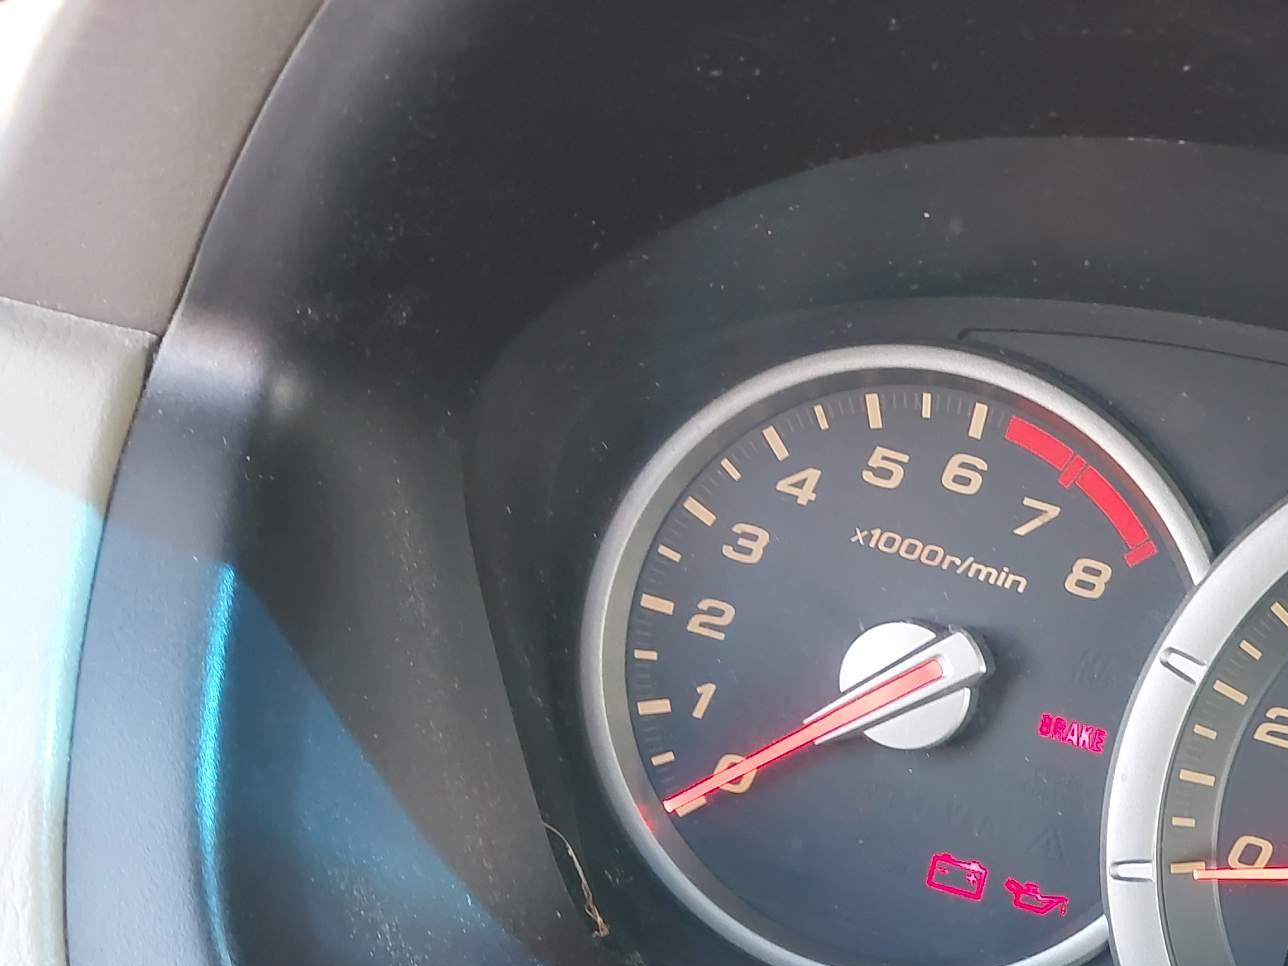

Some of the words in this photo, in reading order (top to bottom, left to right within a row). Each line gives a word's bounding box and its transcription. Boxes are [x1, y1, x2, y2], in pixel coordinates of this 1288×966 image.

[776, 468, 822, 504] 4
[862, 446, 909, 488] 5
[941, 454, 988, 495] 6
[1012, 497, 1060, 535] 7
[722, 523, 770, 564] 3
[850, 527, 1027, 592] x1000r/min
[1064, 558, 1112, 599] 8
[687, 598, 735, 640] 2
[691, 682, 717, 718] 1
[1038, 711, 1107, 752] BRAKE
[712, 754, 757, 794] 0
[1226, 834, 1273, 872] 0
